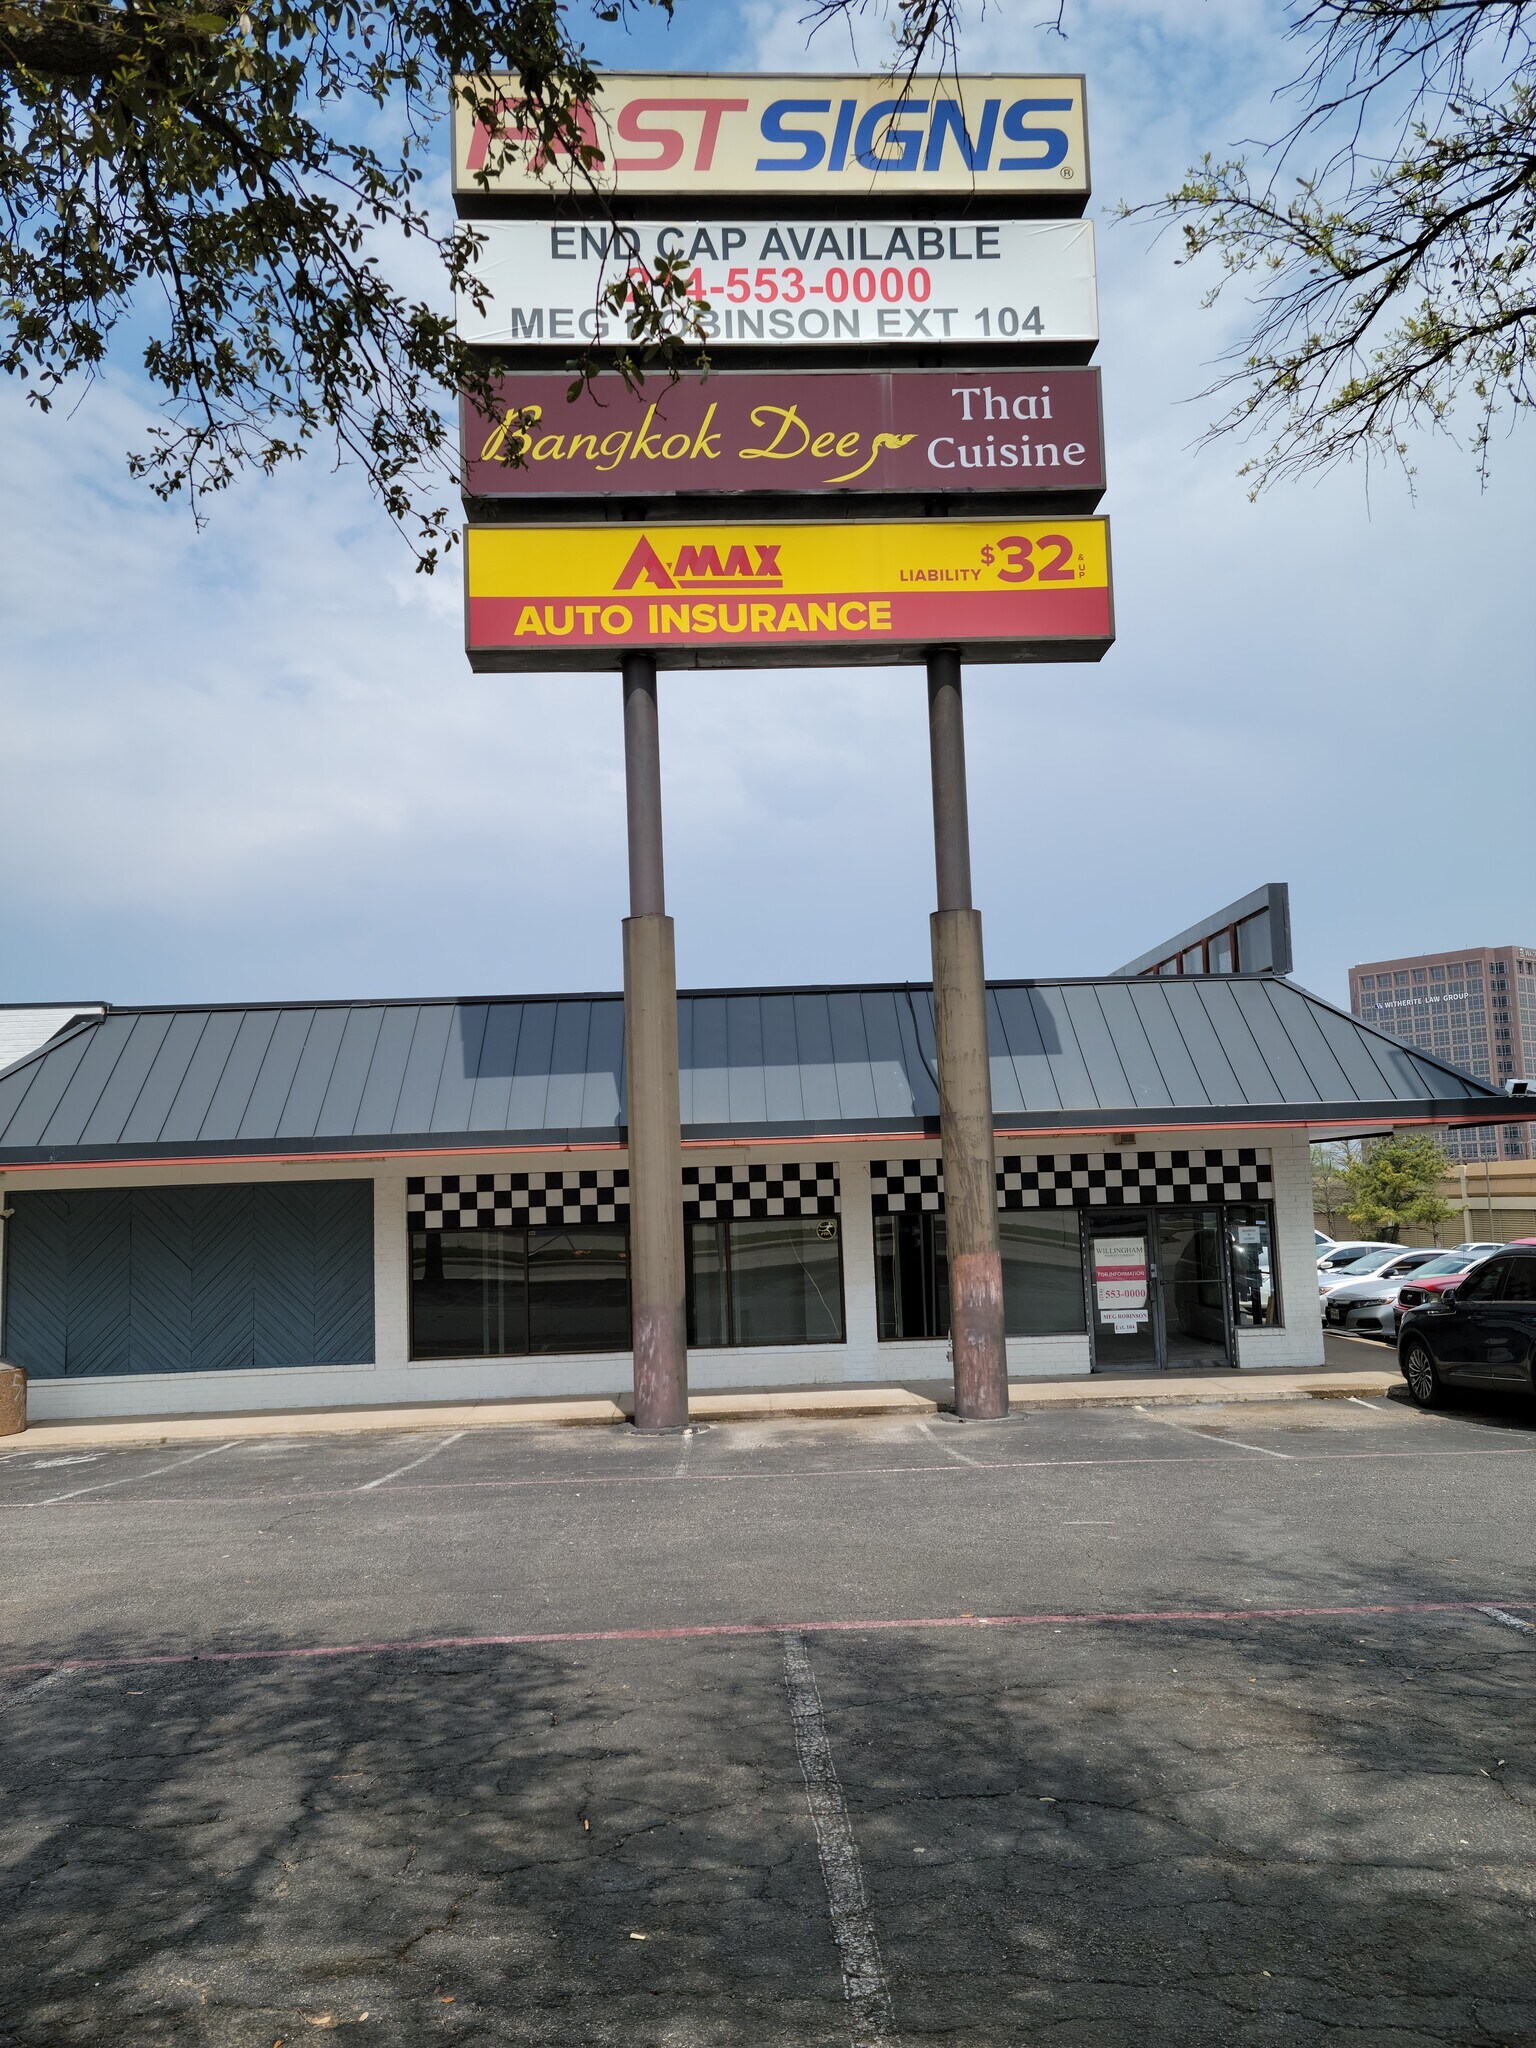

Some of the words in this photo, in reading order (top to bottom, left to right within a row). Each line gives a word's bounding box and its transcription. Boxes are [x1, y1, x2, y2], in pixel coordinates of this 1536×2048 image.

[755, 98, 1074, 171] SIGNS
[551, 227, 641, 260] END
[656, 227, 747, 261] CAP
[759, 226, 1001, 261] AVAILABLE
[625, 266, 931, 304] 24-553-0000
[511, 307, 610, 339] MEG
[877, 308, 959, 338] EXT
[974, 305, 1045, 337] 104
[952, 385, 1053, 421] Thai
[480, 402, 722, 471] Bangkok
[738, 404, 860, 459] Dee
[927, 434, 1086, 469] Cuisine
[900, 569, 981, 582] LIABILITY
[514, 605, 633, 636] AUTO
[649, 601, 892, 635] INSURANCE
[1384, 998, 1422, 1009] WITHERITE
[1425, 995, 1441, 1004] LAW
[1443, 992, 1469, 1002] GROUP
[1105, 1289, 1146, 1299] 553-0000
